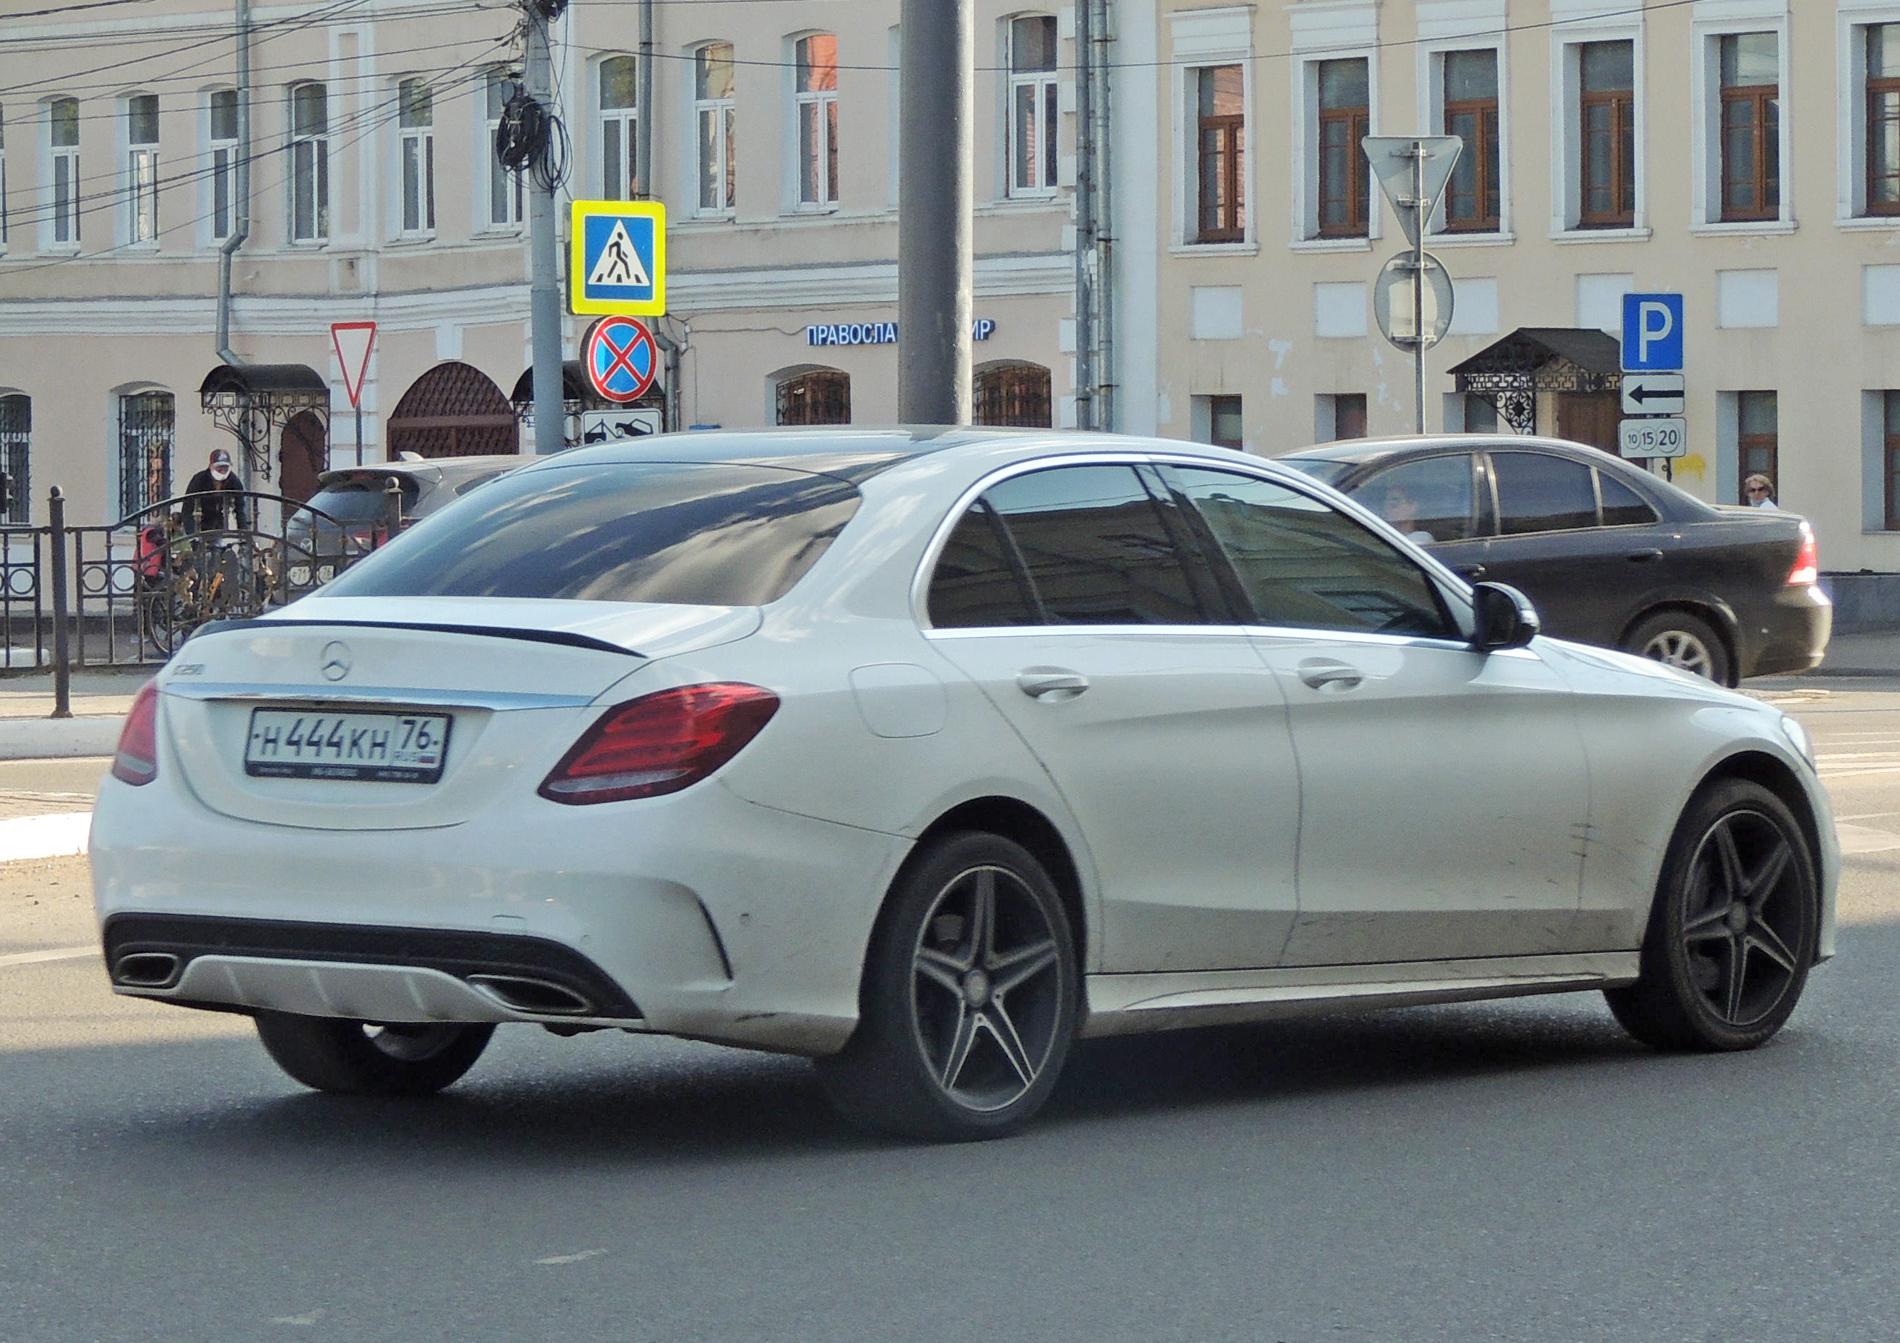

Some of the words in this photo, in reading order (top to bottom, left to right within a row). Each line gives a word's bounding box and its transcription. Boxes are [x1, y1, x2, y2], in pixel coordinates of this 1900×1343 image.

[807, 323, 897, 346] ПРАВОСЛА
[972, 319, 991, 341] ИР
[1639, 301, 1672, 362] P
[1628, 434, 1638, 444] 10
[1642, 432, 1654, 446] 15
[1659, 429, 1677, 446] 20
[401, 719, 431, 750] 76
